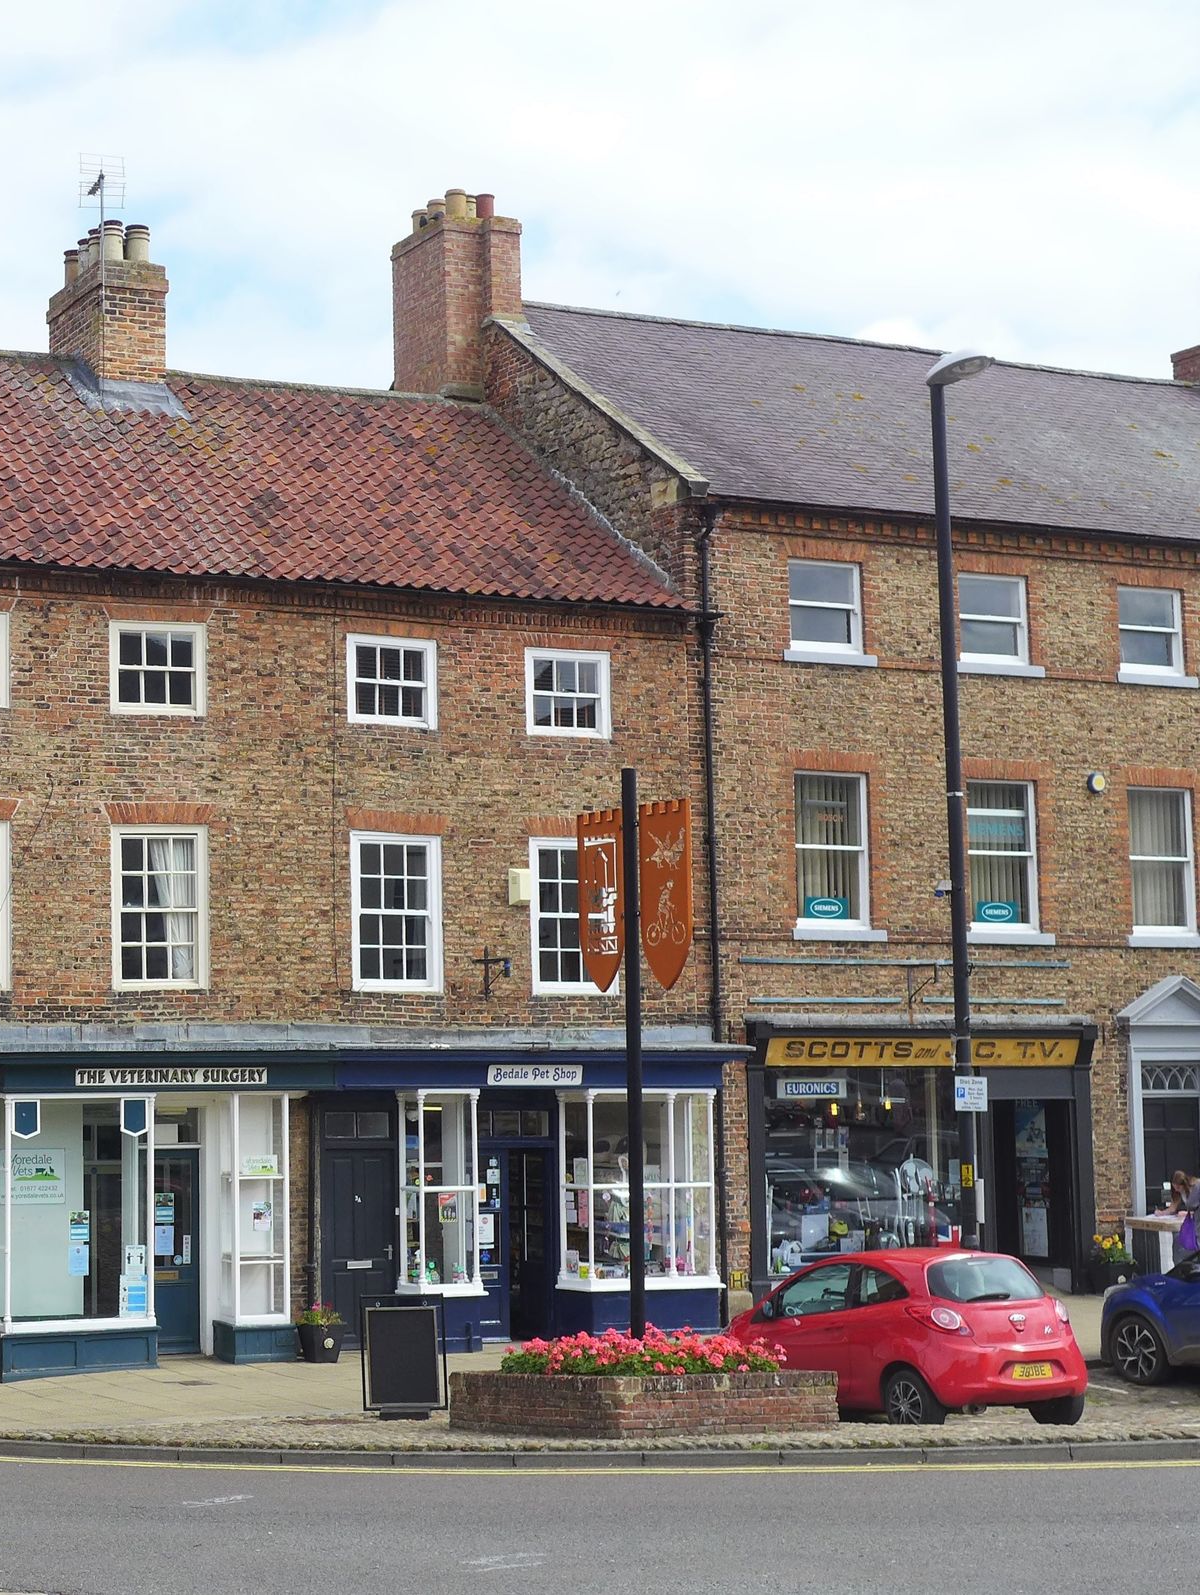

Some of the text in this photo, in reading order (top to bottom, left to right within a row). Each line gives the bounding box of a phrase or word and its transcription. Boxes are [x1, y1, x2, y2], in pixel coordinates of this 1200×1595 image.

[813, 904, 839, 912] SIEMENS
[984, 908, 1009, 916] SIEMENS
[784, 1041, 915, 1059] SCOTTS
[914, 1044, 942, 1059] and
[77, 1068, 265, 1084] THE VETERINARY SURGERY
[493, 1066, 578, 1082] Bedale Pet Shop
[785, 1082, 838, 1095] EURONICS
